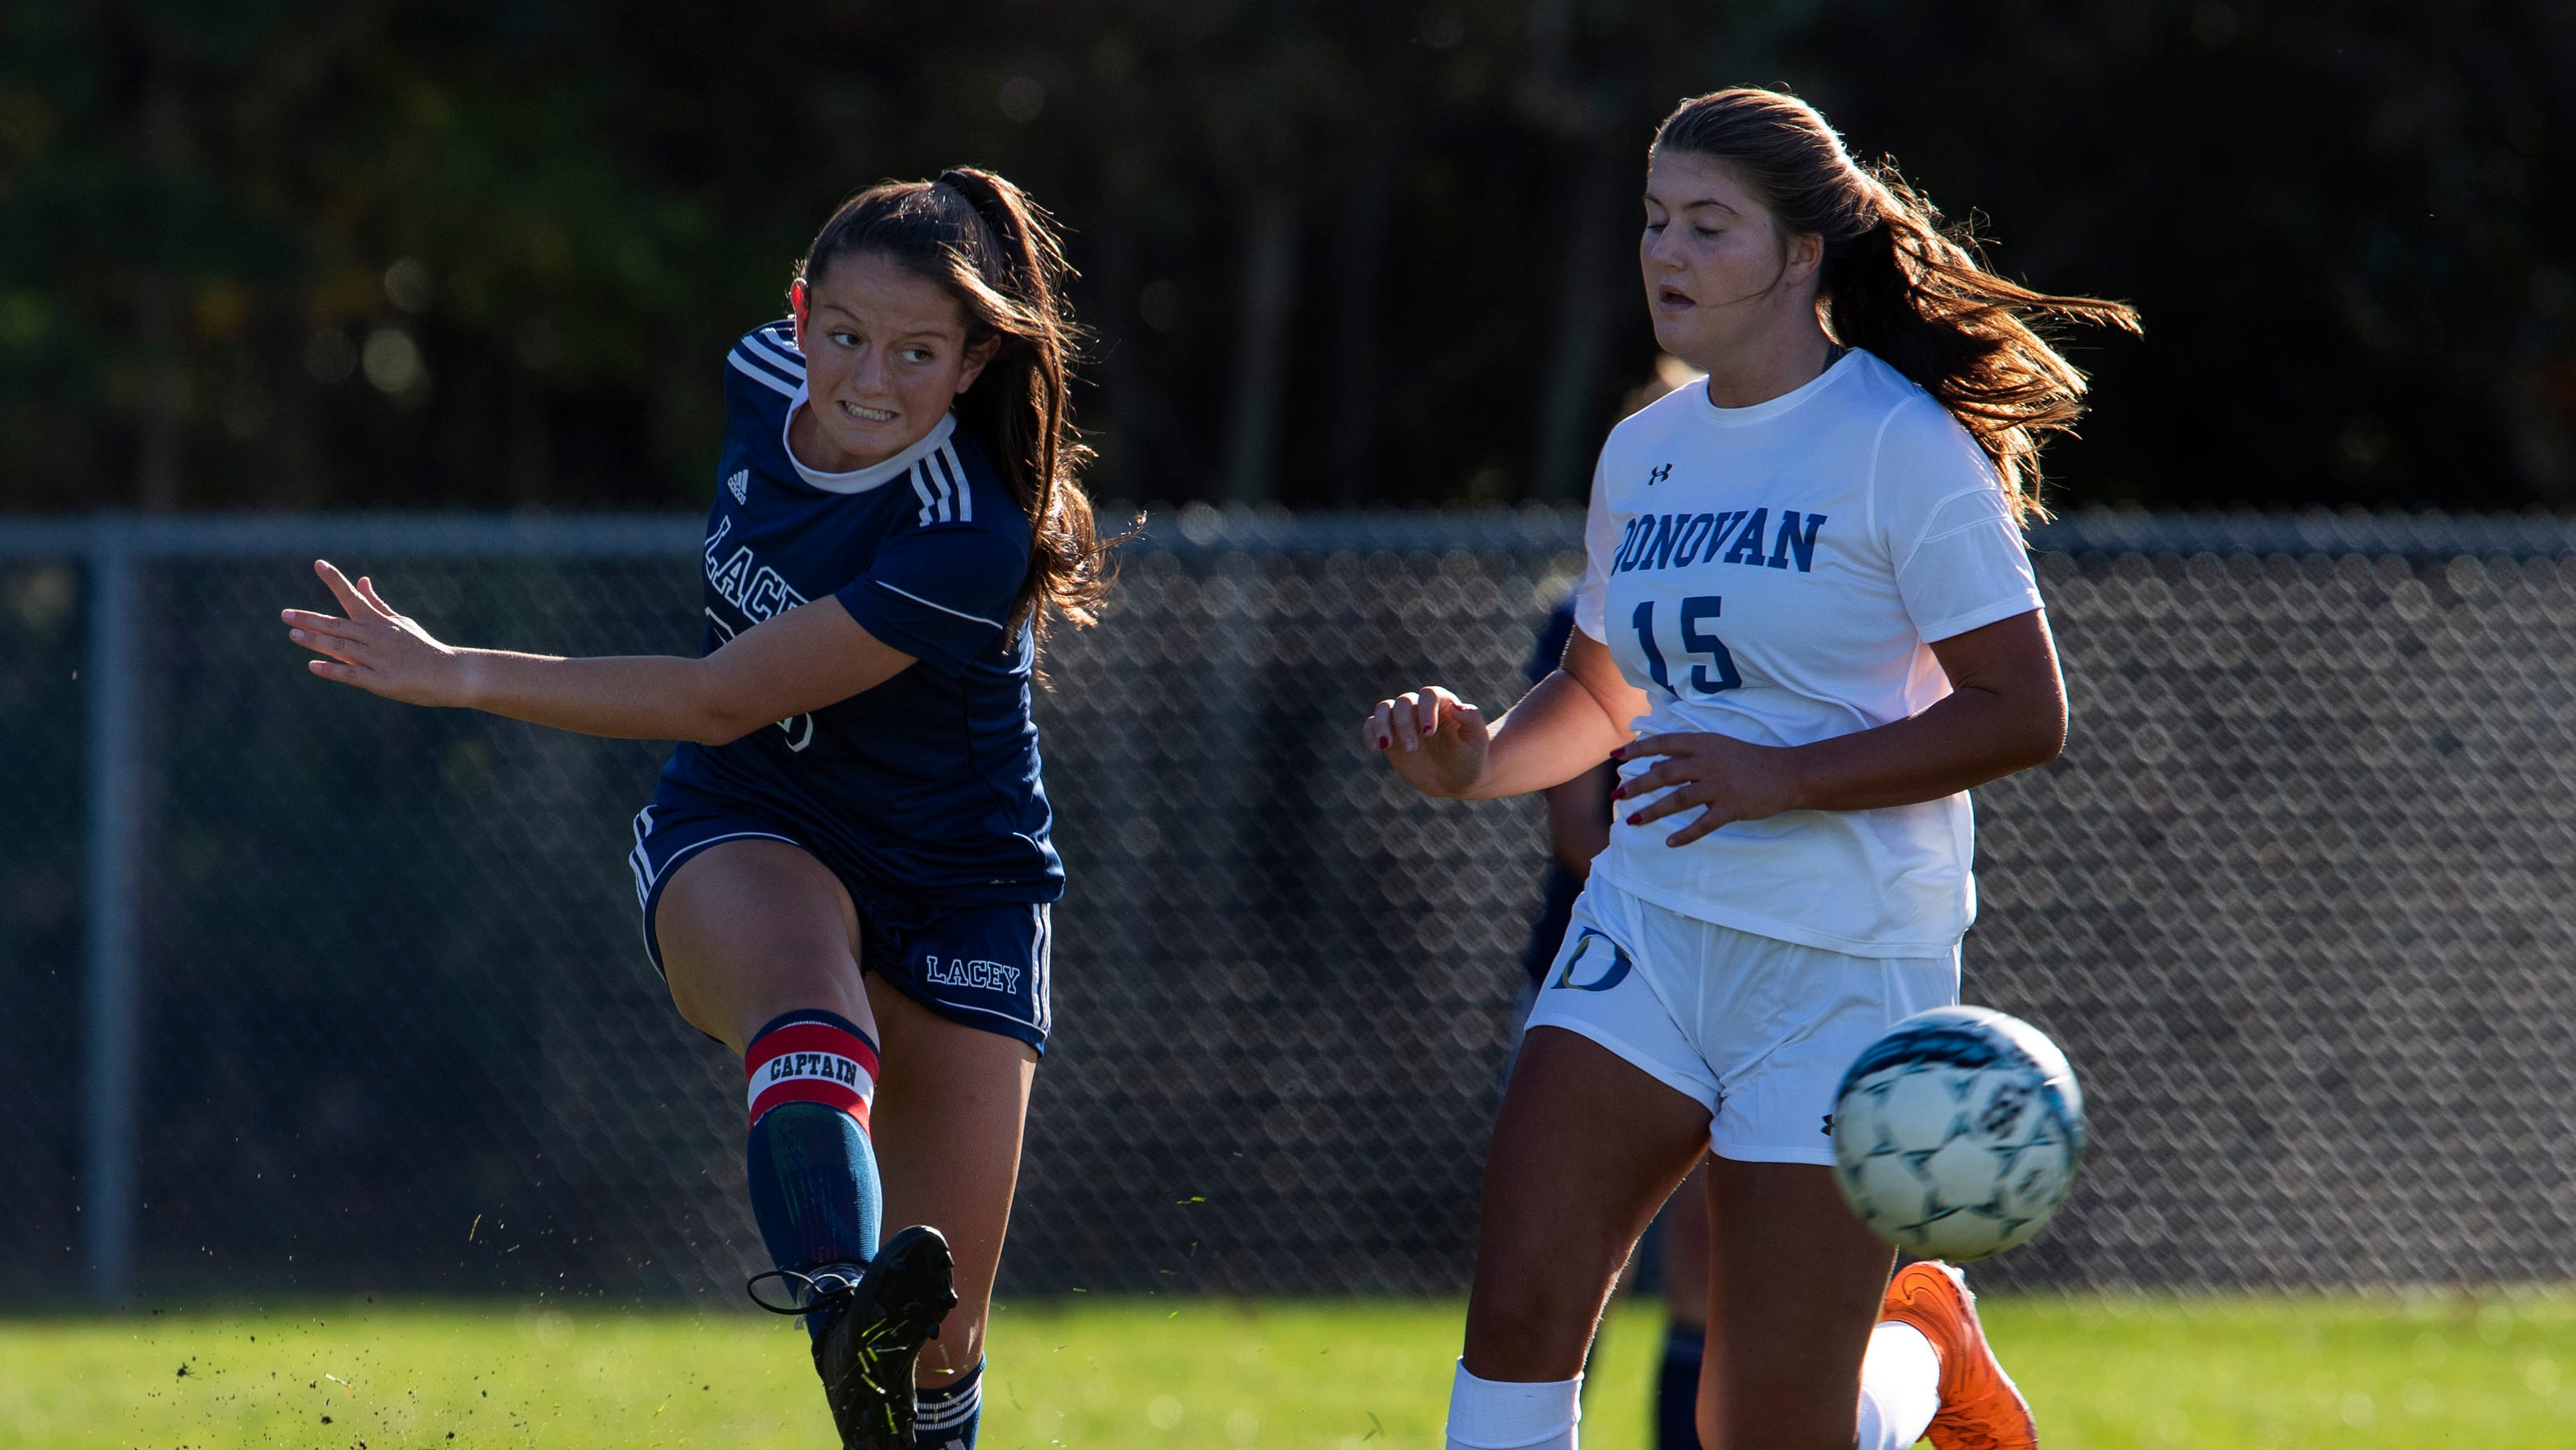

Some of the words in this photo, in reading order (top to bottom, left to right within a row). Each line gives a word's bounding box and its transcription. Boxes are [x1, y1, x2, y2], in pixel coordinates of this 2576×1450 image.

[728, 477, 746, 506] adidas
[1633, 596, 1742, 701] 15
[927, 956, 1020, 994] LACEY
[770, 1054, 857, 1087] CAPTAIN
